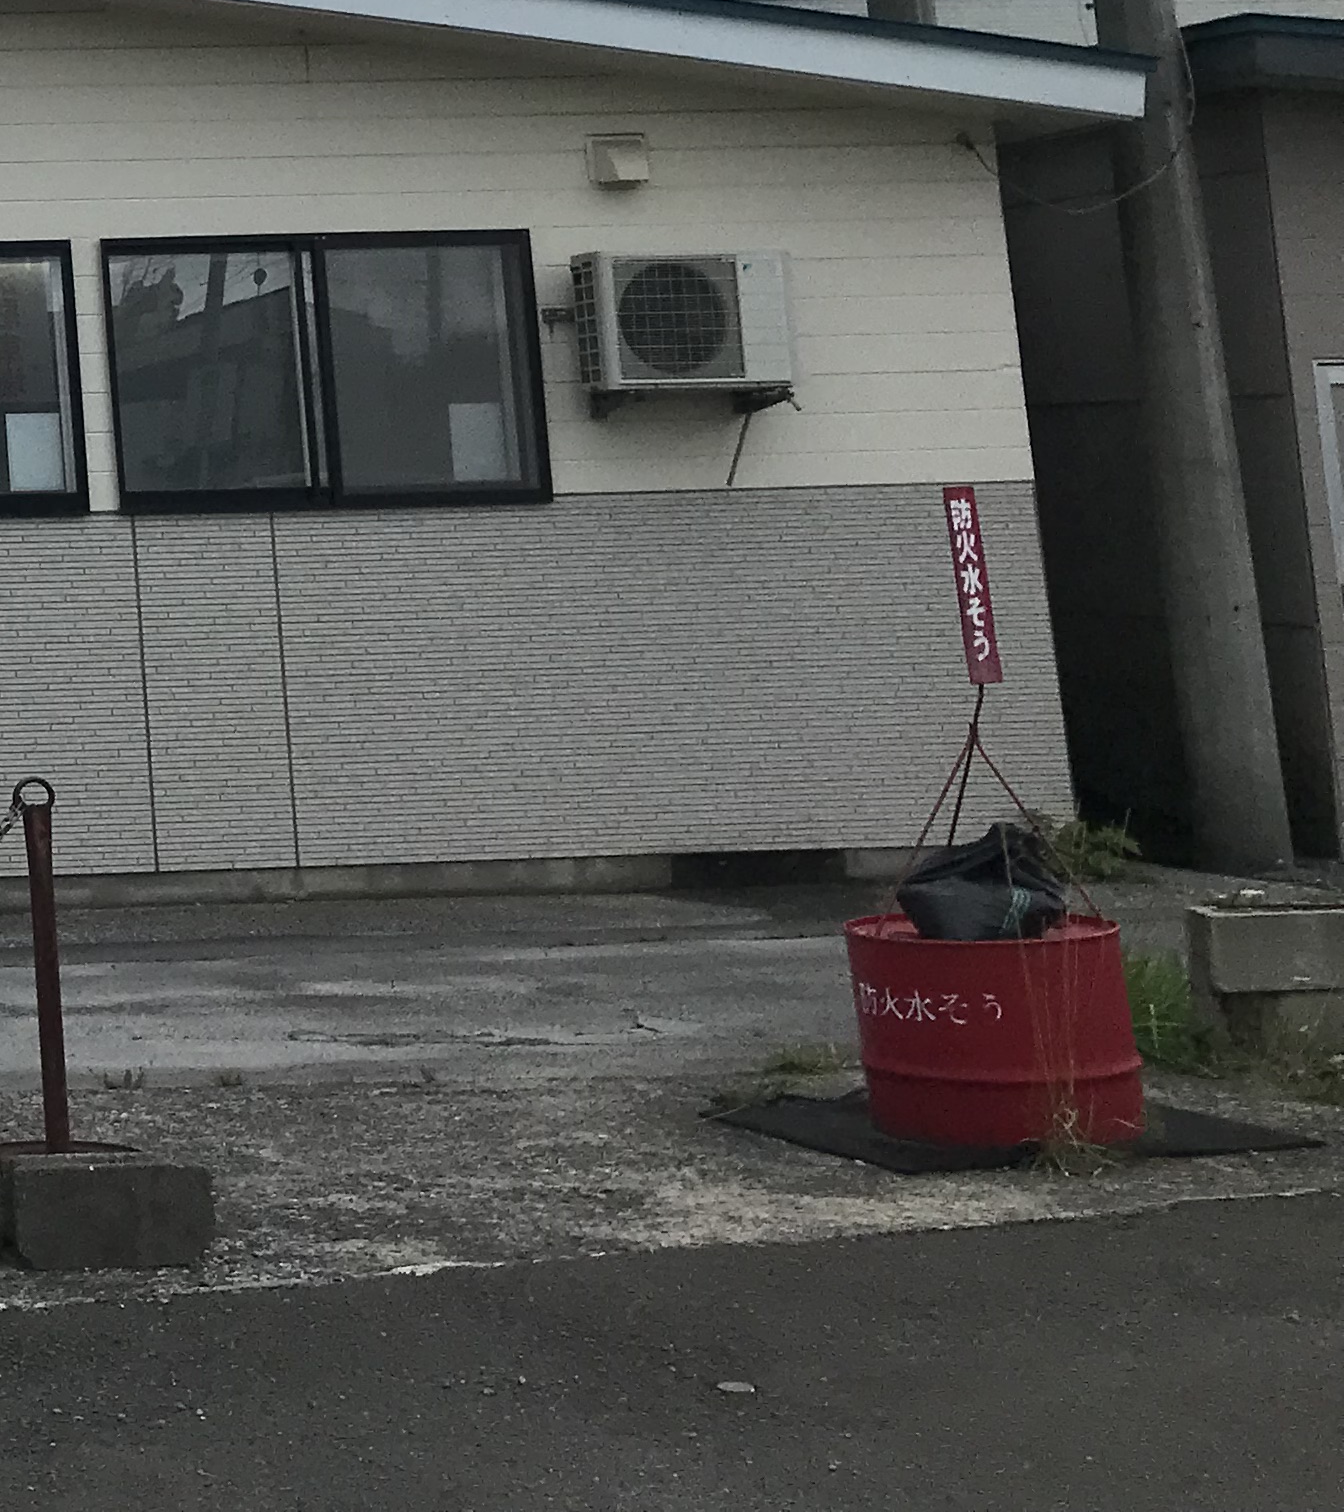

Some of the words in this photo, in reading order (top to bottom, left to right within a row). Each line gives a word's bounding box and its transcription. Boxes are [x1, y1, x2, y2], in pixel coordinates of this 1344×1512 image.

[950, 498, 990, 662] 防火水そう
